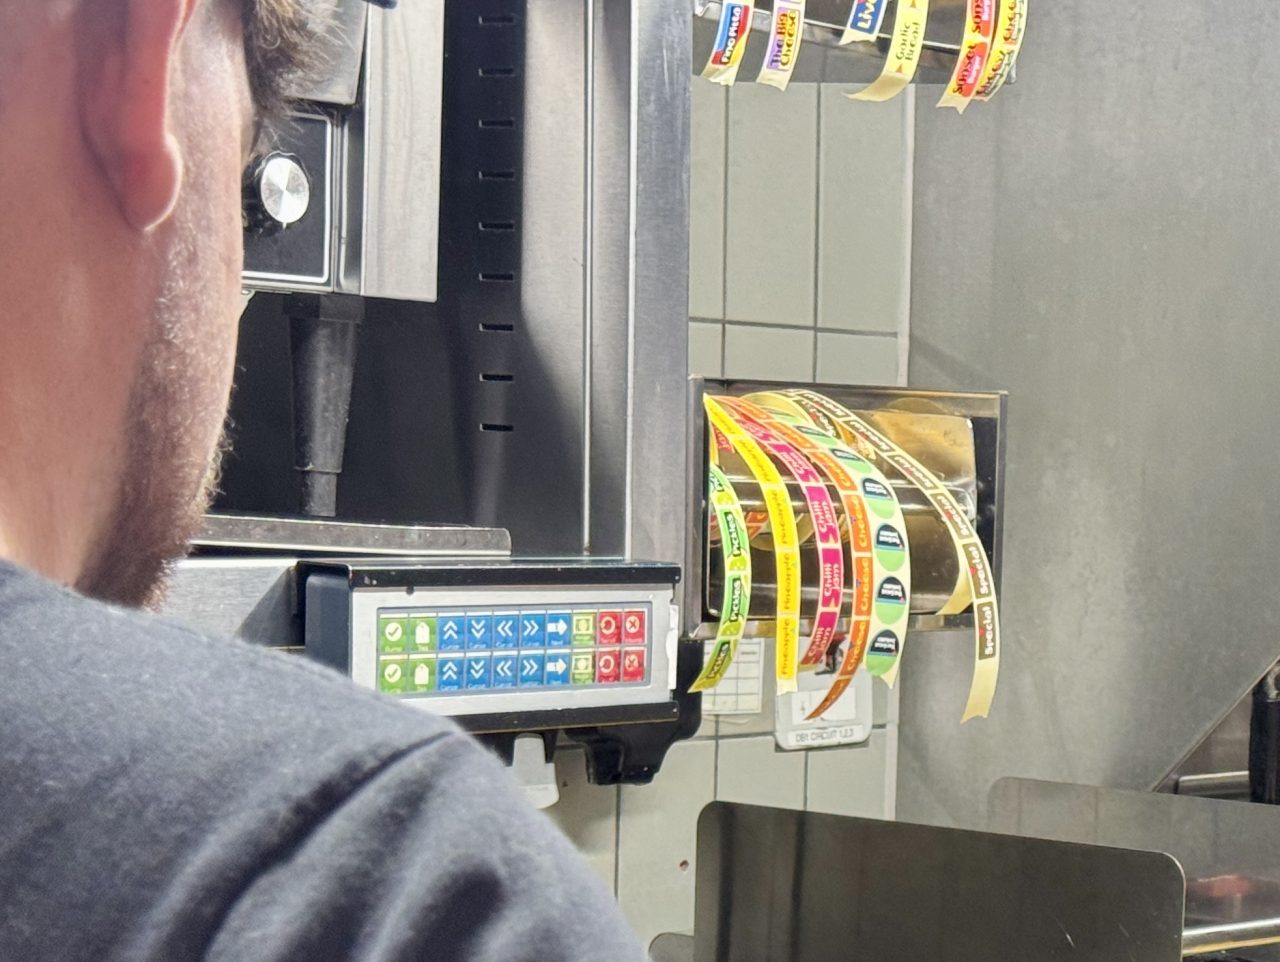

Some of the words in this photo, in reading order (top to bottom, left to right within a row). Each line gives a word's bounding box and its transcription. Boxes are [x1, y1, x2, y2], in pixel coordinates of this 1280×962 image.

[776, 13, 788, 36] Big
[780, 9, 797, 67] Cheese
[895, 22, 911, 60] Garlic
[904, 21, 920, 61] Bread
[769, 39, 785, 67] The
[952, 44, 977, 95] Sunset
[726, 513, 741, 554] Pickles
[811, 500, 827, 533] Chilli
[821, 500, 835, 529] Jam
[852, 495, 868, 548] Cheese
[936, 494, 971, 536] Special
[783, 552, 793, 611] Pineapple
[823, 562, 833, 597] Chilli
[832, 562, 841, 592] Jam
[861, 558, 870, 610] Cheese
[967, 545, 989, 596] Special
[730, 579, 741, 621] Pickles
[779, 619, 792, 676] Pineapple
[807, 627, 824, 657] Chilli
[847, 621, 866, 671] Cheese
[983, 605, 994, 657] Special
